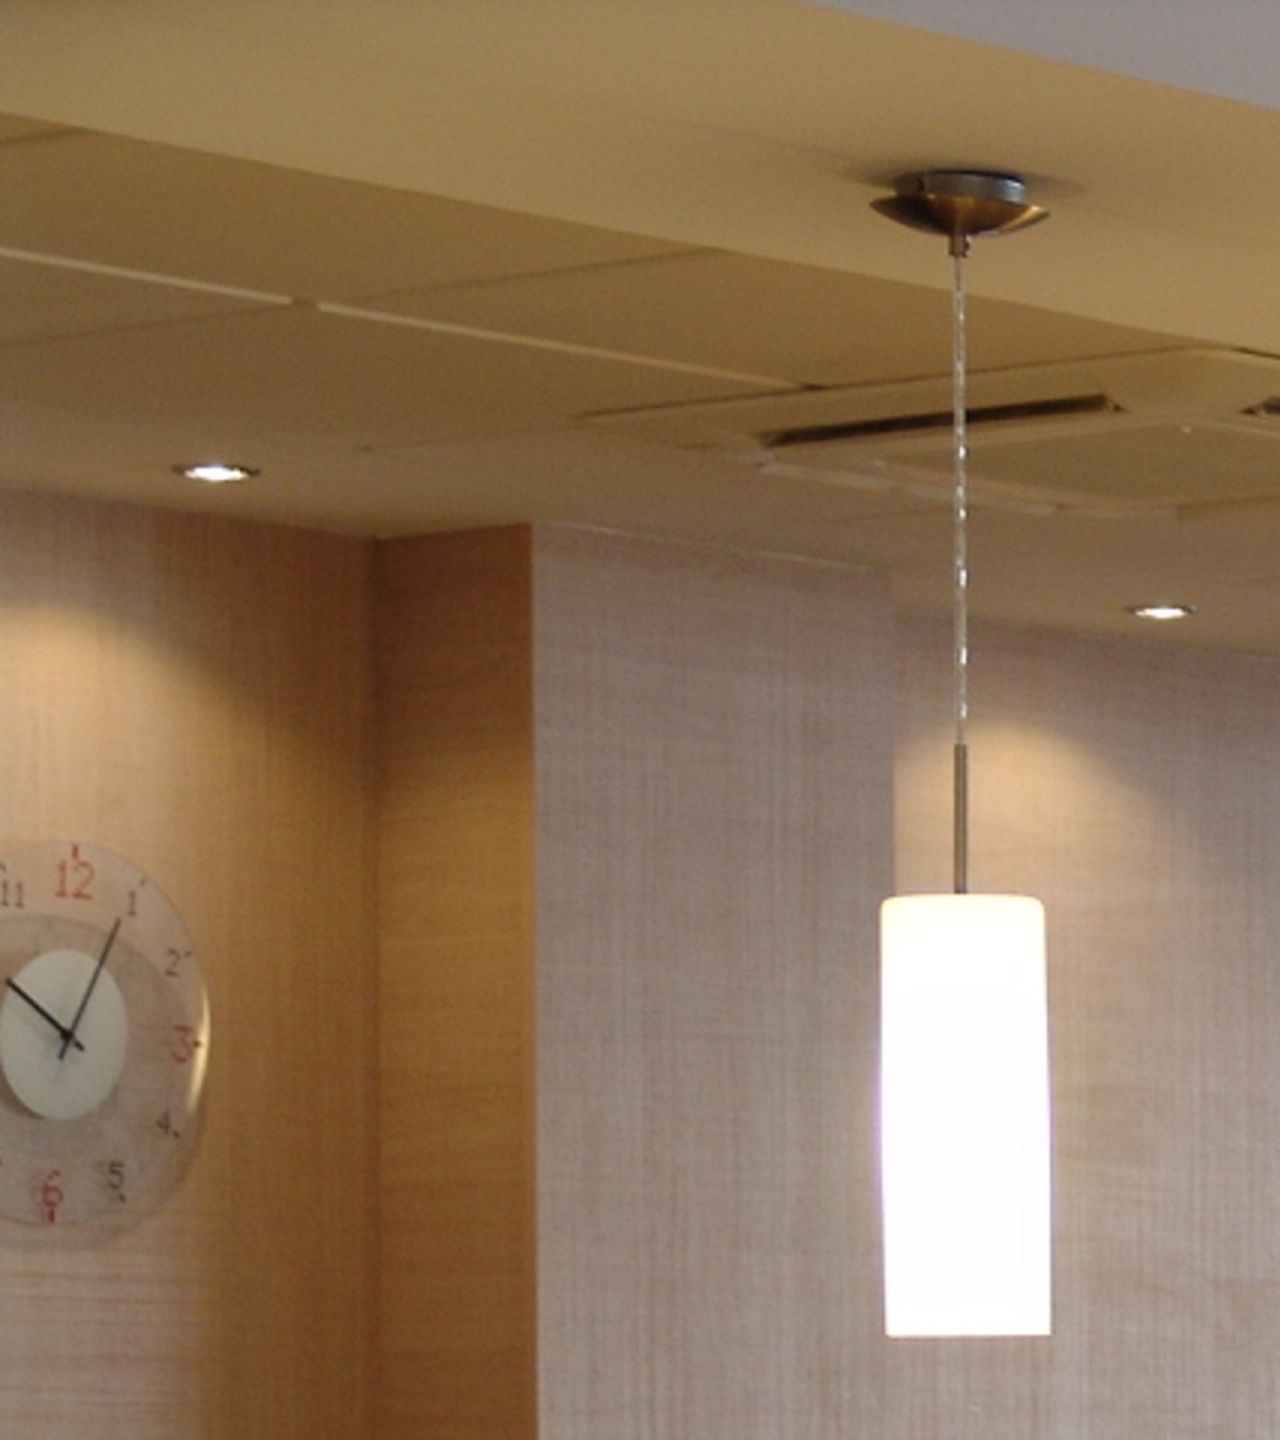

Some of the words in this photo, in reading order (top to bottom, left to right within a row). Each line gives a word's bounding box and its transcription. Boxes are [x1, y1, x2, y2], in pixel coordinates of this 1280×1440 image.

[54, 859, 94, 901] 12
[164, 947, 182, 977] 2
[171, 1024, 193, 1064] 3
[156, 1110, 172, 1135] 4
[41, 1168, 64, 1208] 6
[107, 1160, 125, 1190] 5
